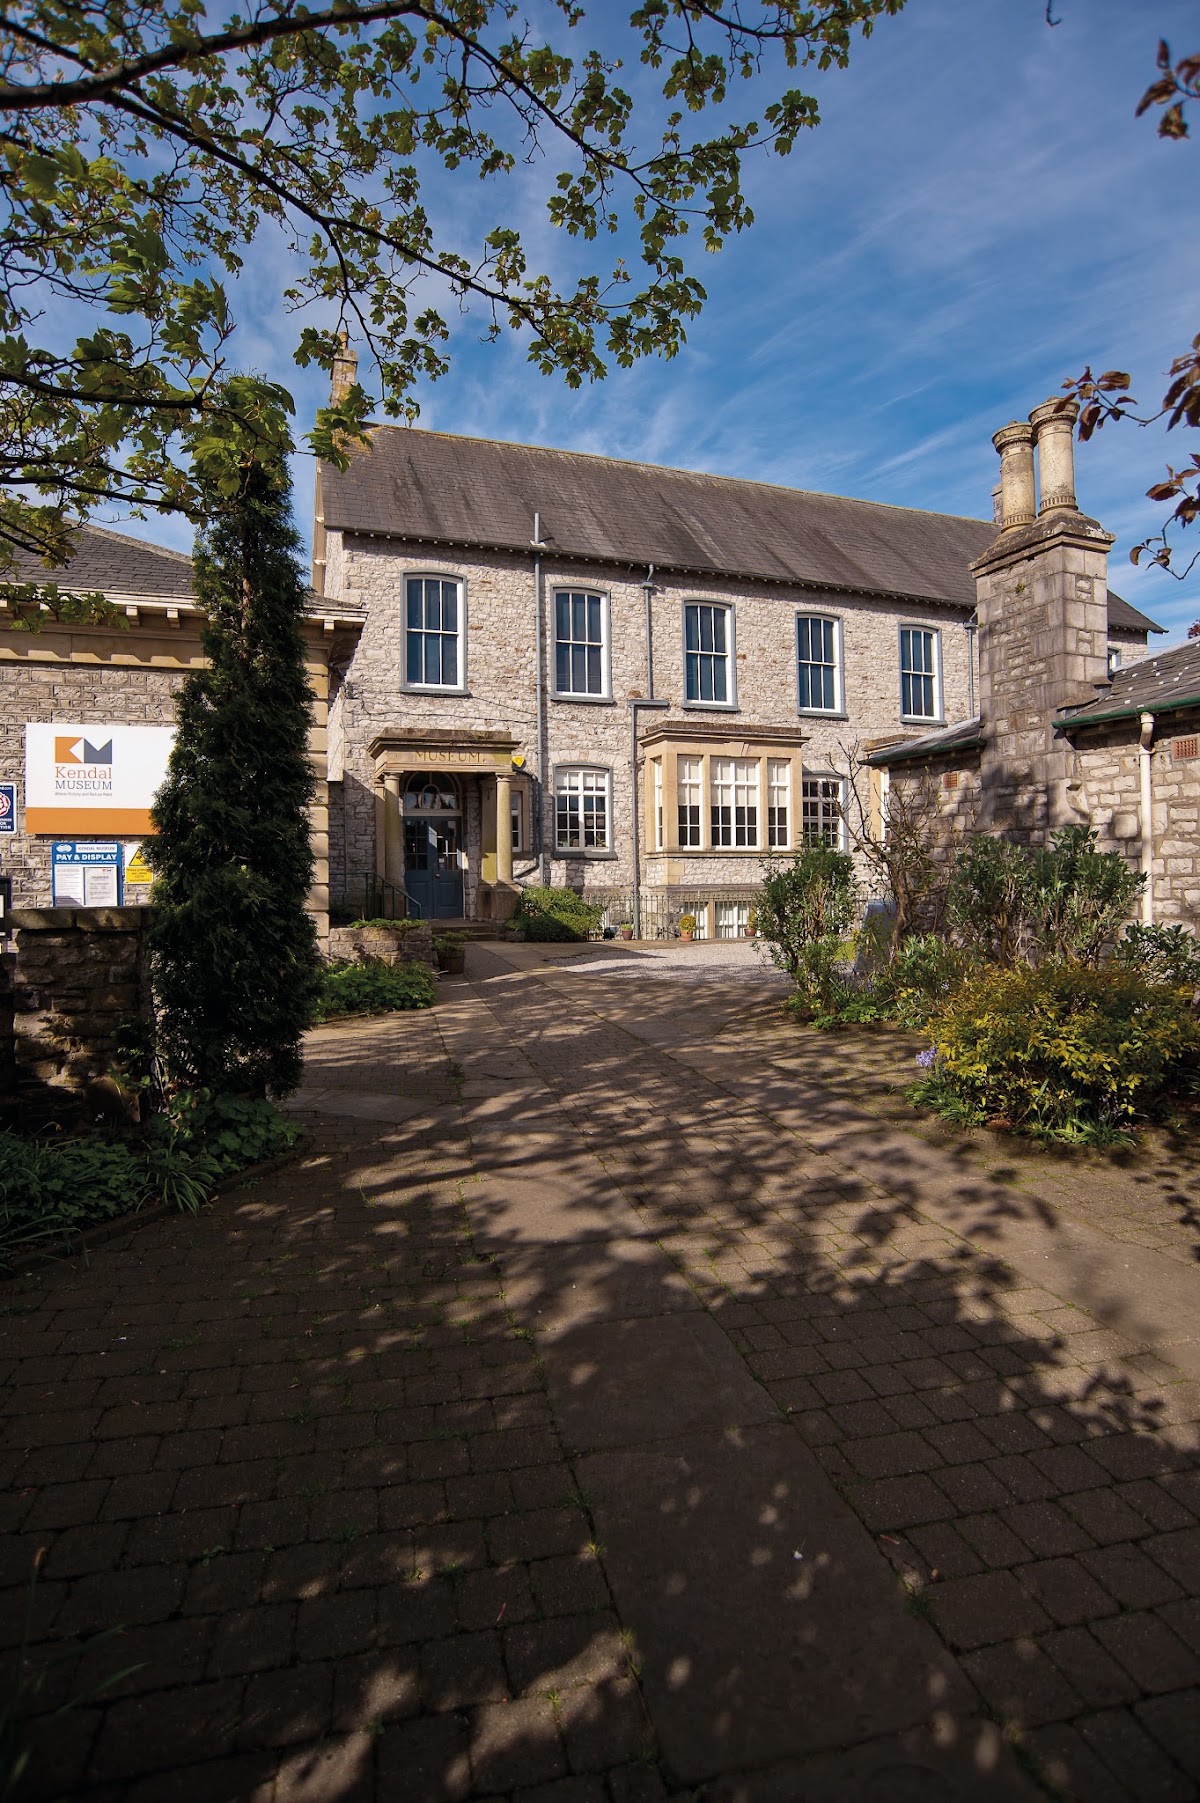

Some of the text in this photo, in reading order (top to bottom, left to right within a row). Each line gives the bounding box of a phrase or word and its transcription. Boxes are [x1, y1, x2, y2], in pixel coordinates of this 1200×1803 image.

[55, 766, 112, 779] Kendal
[55, 780, 112, 790] MUSEUM
[56, 853, 117, 861] PAY & DISPLAY
